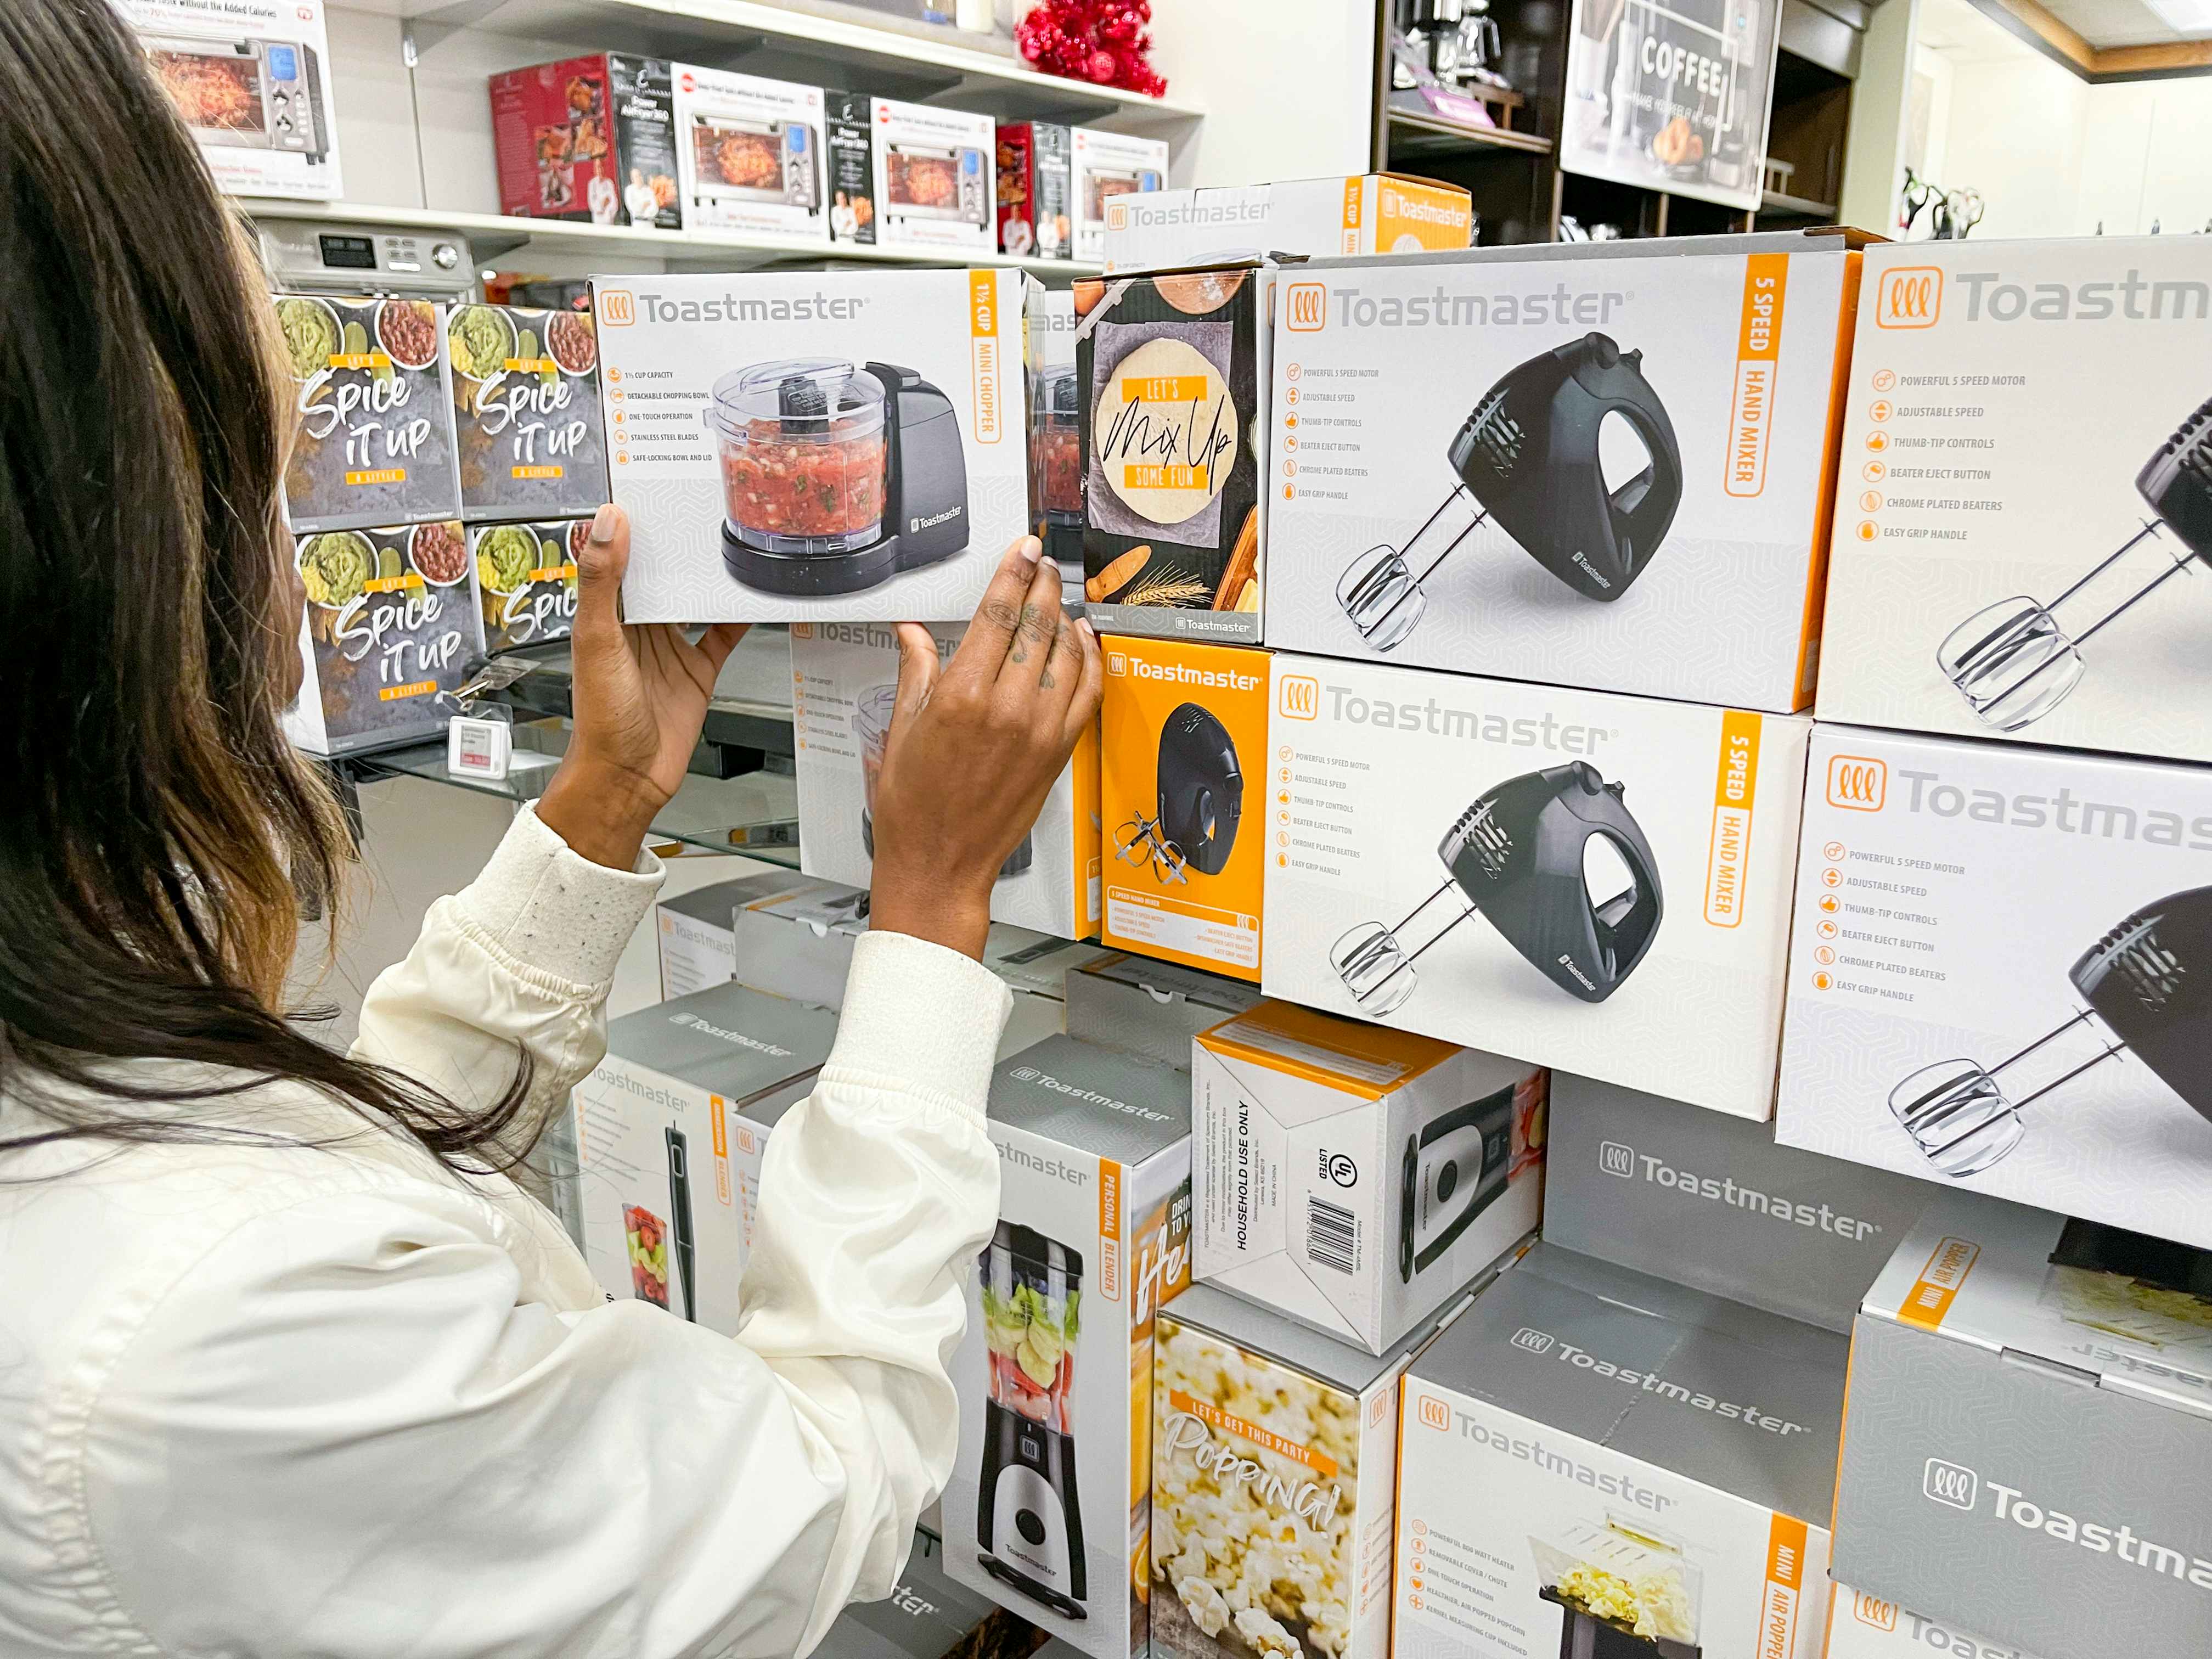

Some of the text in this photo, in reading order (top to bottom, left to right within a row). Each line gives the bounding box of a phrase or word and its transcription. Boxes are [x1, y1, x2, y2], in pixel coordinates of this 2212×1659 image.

[1641, 36, 1723, 97] COFFEE
[1130, 199, 1270, 227] Toastmaster
[1347, 206, 1358, 225] CUP
[1397, 195, 1467, 228] Toastmaster
[639, 291, 863, 323] Toastmaster
[1332, 282, 1624, 328] Toastmaster
[977, 306, 994, 433] CUP MINI CHOPPER
[1303, 369, 1379, 378] POWERFUL SPEED MOTOR
[1735, 277, 1775, 482] 5 SPEED HAND MIXER
[1900, 375, 2026, 386] POWERFUL 5 SPEED MOTOR
[475, 370, 573, 436] Spice
[1147, 379, 1179, 400] LET'S
[1302, 393, 1355, 402] ADJUSTABLE SPEED
[298, 368, 412, 440] Spice
[1896, 407, 1984, 417] ADJUSTABLE SPEED
[1302, 418, 1362, 427] THUMB-TIP CONTROLS
[1102, 394, 1232, 496] Mix Up
[1300, 441, 1361, 452] BEATER EJECT BUTTON
[1893, 437, 1995, 448] THUMB-TIP CONTROLS
[1135, 467, 1194, 486] SOME FUN
[1299, 465, 1369, 477] CHROME PLATED BEATERS
[1890, 468, 1991, 480] BEATER EJECT BUTTON
[1298, 489, 1348, 500] EASY GRIP HANDLE
[1887, 498, 2003, 511] CHROME PLATED BEATERS
[919, 506, 962, 531] Toastmaster
[1883, 527, 1968, 541] EASY GRIP HANDLE
[1578, 556, 1612, 589] Toastmaster
[335, 590, 444, 662] Spice
[1186, 618, 1250, 634] Toastmaster
[1129, 657, 1260, 691] Toastmaster
[1325, 684, 1609, 755] Toastmaster
[1296, 752, 1370, 771] POWERFUL SPEED MOTOR
[1294, 774, 1347, 789] ADJUSTABLE SPEED
[1294, 796, 1354, 813] THUMB-TIP CONTROLS
[1293, 817, 1353, 835] BEATER EJECT BUTTON
[1714, 735, 1749, 915] 5 SPEED HAND MIXER
[1292, 839, 1361, 858] CHROME PLATED BEATERS
[1292, 859, 1341, 876] EASY GRIP HANDLE
[1849, 850, 1966, 875] POWERFUL SPEED MOTOR
[1846, 877, 1928, 896] ADJUSTABLE SPEED
[1844, 903, 1938, 926] THUMB-TIP CONTROLS
[1842, 929, 1935, 952] BEATER EJECT BUTTON
[1838, 955, 1946, 982] CHROME PLATED BEATERS
[1837, 980, 1915, 1002] EASY GRIP HANDLE
[688, 1017, 792, 1059] Toastmaster
[1036, 1074, 1172, 1123] Toastmaster
[1237, 1100, 1248, 1251] HOUSEHOLD USE ONLY
[1319, 1148, 1328, 1179] LISTED
[1639, 1153, 1874, 1241] Toastmaster
[1104, 1173, 1116, 1292] PERSONAL BLENDER
[1172, 1217, 1182, 1236] TO
[1939, 1242, 1971, 1272] POPPER
[1558, 1342, 1802, 1436] Toastmaster
[1192, 1402, 1310, 1464] LET'S GET THIS PARTY
[1455, 1411, 1672, 1514] Toastmaster
[1005, 1544, 1058, 1577] Toastmaster
[1429, 1529, 1515, 1571] POWERFUL WATT HEATER
[1775, 1543, 1796, 1581] MINI
[1428, 1548, 1508, 1588] REMOVABLE CHUTE
[1440, 1572, 1494, 1602] TOUCH OPERATION
[1771, 1589, 1789, 1615] AIR
[1449, 1615, 1528, 1656] MEASURING INCLUDED
